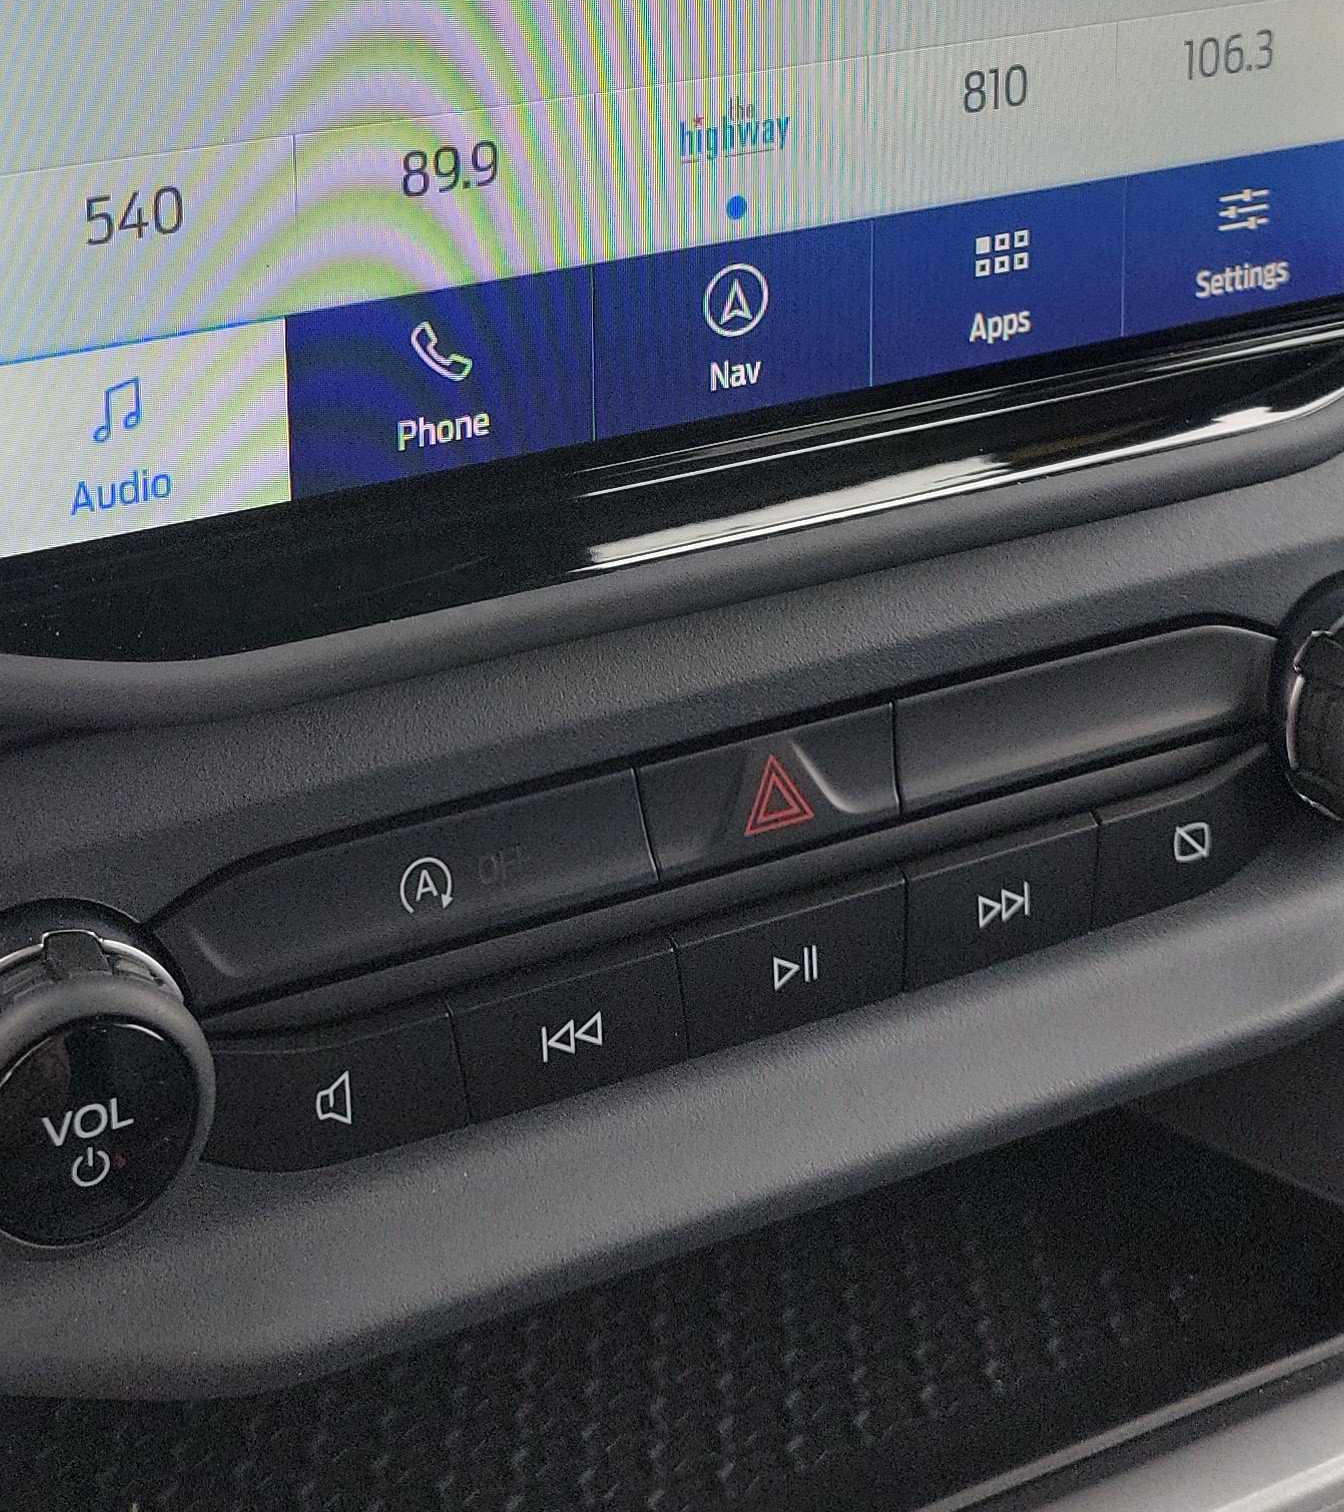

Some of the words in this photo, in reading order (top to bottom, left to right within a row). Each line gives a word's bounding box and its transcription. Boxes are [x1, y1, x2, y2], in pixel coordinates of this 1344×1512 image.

[1182, 29, 1275, 81] 106.3
[962, 64, 1029, 114] 810
[680, 115, 790, 160] highway
[401, 140, 500, 198] 89.9
[85, 185, 185, 246] 540
[1195, 258, 1290, 300] Settings
[969, 308, 1031, 345] Apps
[709, 357, 762, 391] Nav
[396, 410, 492, 452] Phone
[70, 470, 173, 517] Audio
[42, 1097, 135, 1148] VOL
